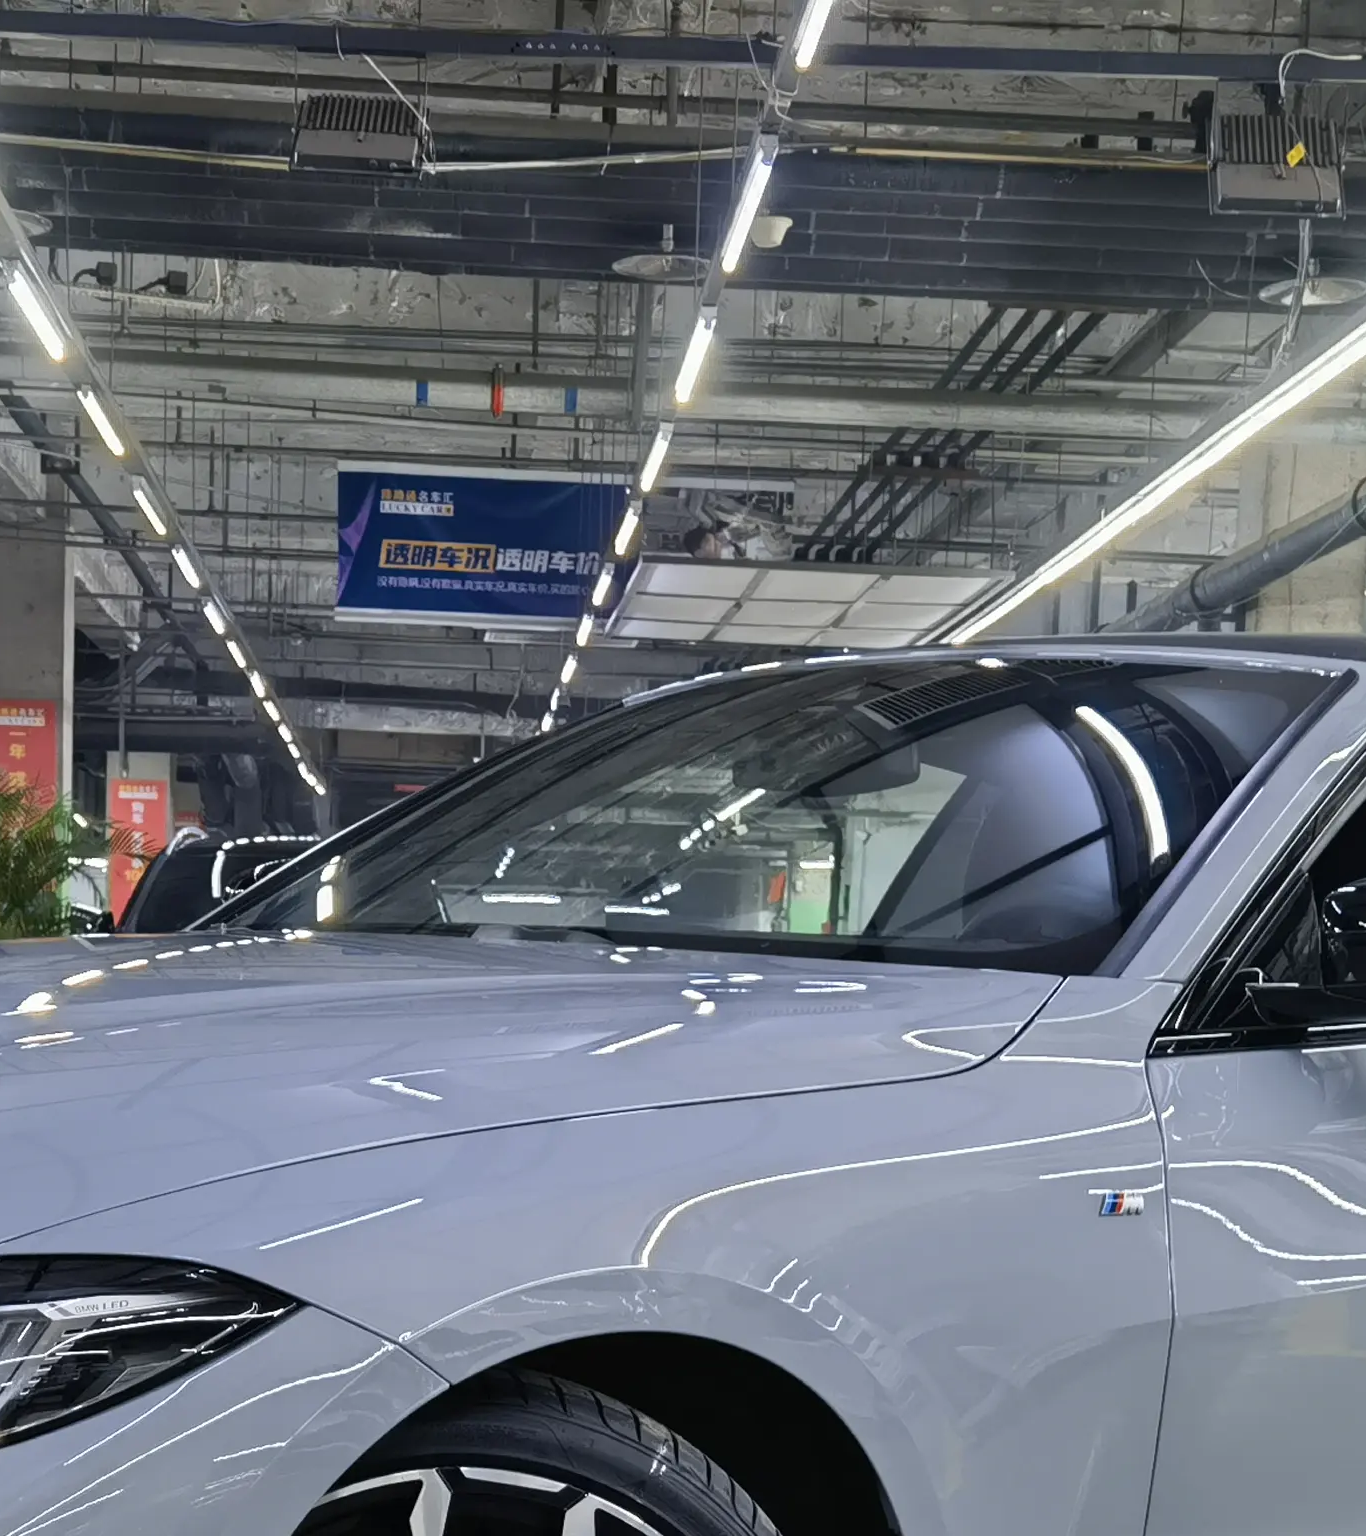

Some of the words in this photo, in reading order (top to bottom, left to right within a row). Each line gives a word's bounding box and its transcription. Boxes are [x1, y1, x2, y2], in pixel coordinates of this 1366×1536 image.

[384, 542, 492, 570] 透明车况
[495, 548, 600, 576] 透明车价
